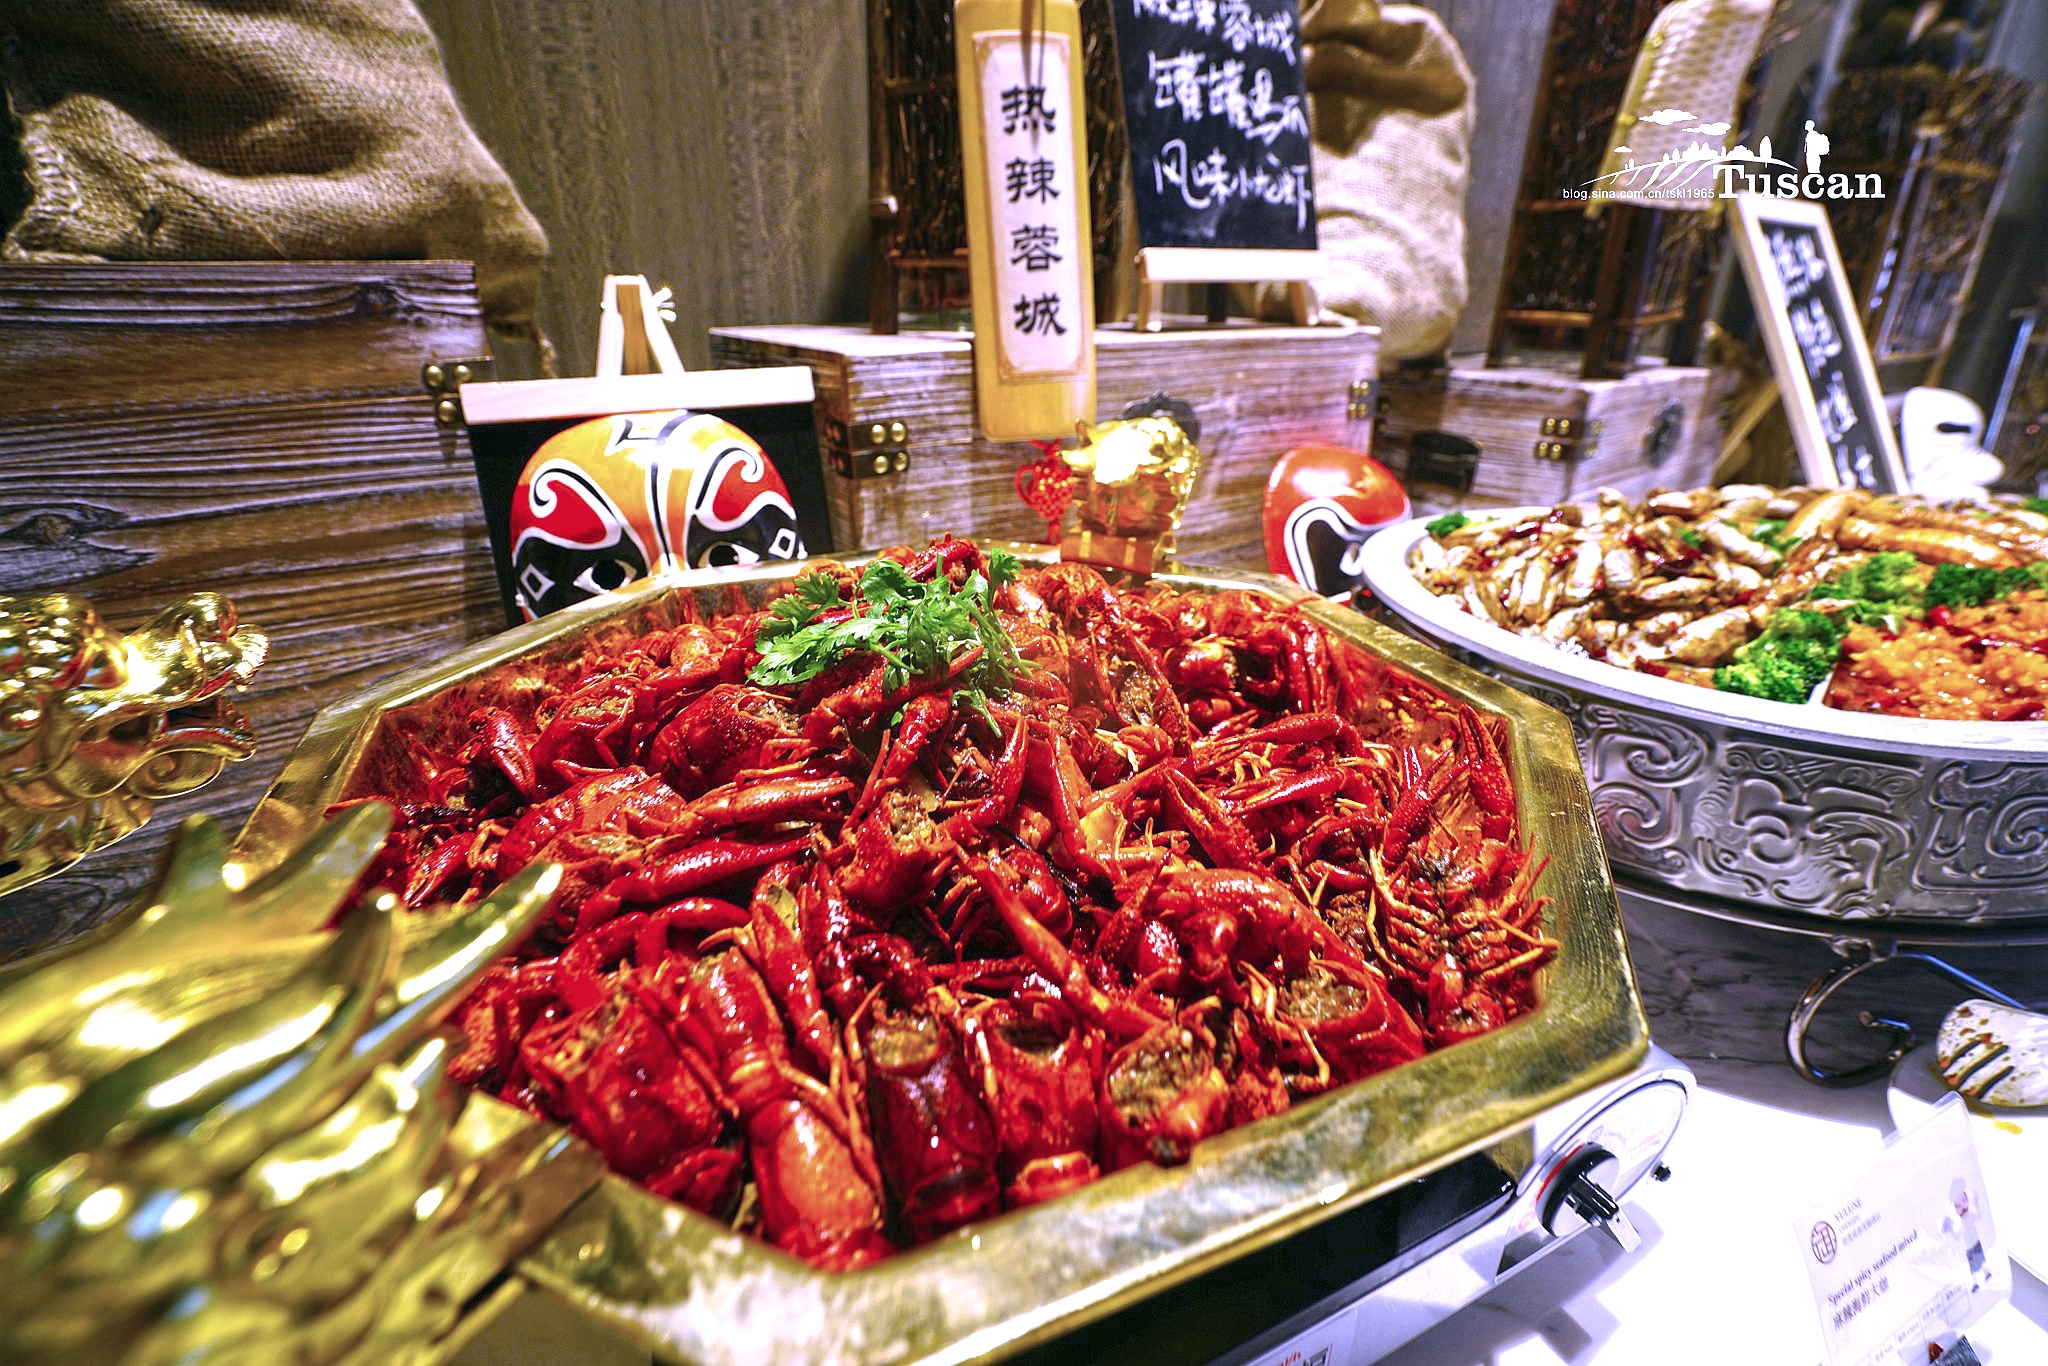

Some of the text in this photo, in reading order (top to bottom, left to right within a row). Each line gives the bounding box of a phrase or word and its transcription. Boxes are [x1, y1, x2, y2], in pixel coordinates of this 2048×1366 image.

[1000, 84, 1067, 338] 热辣蓉城
[1827, 1228, 1918, 1306] Special spicy seafood mixed
